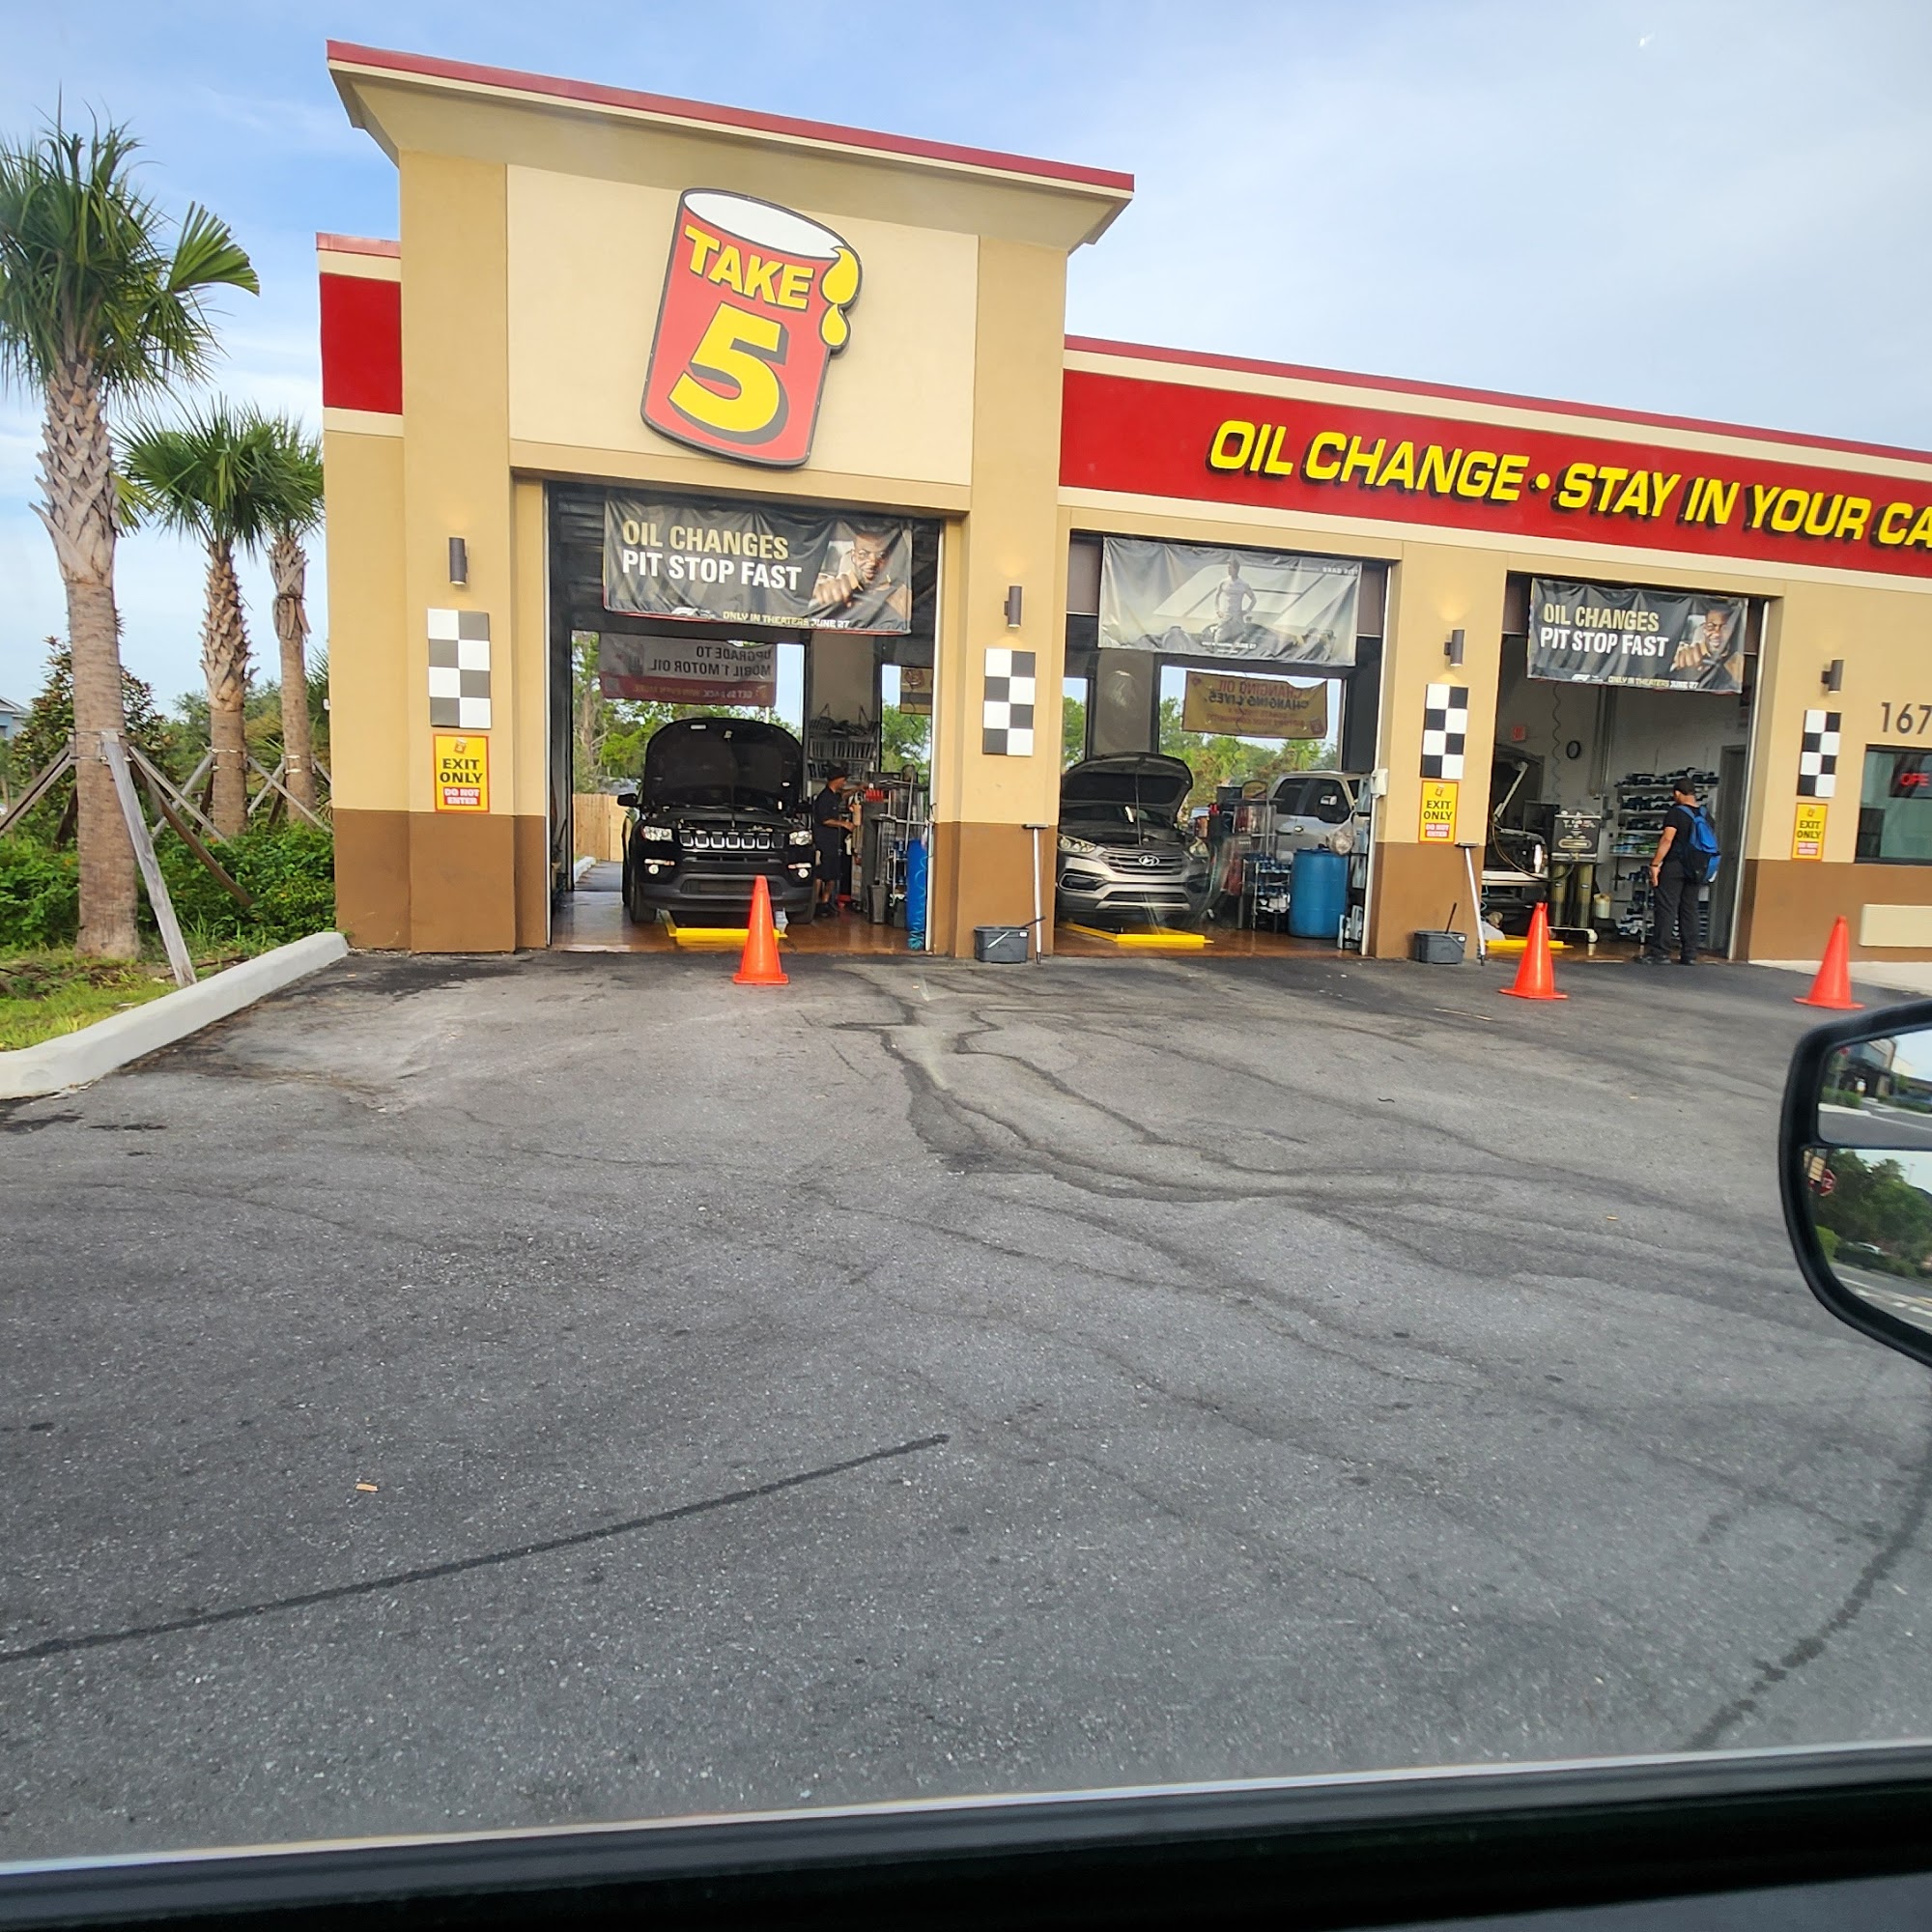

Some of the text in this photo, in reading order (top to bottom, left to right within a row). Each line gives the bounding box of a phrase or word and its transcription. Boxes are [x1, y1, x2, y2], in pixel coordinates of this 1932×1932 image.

[684, 224, 814, 310] TAKE
[668, 300, 788, 442] 5
[1209, 419, 1294, 475] OIL
[1304, 431, 1530, 501] CHANGE
[1557, 462, 1682, 518] STAY
[1684, 477, 1741, 526] IN
[1750, 484, 1872, 541] YOUR
[622, 520, 789, 561] OIL CHANGES
[622, 550, 803, 591] PIT STOP FAST
[723, 611, 750, 622] ONLY
[750, 613, 761, 623] IN
[762, 614, 810, 627] THEATERS
[810, 618, 837, 628] JUNE
[838, 619, 851, 629] 27
[1544, 603, 1660, 633] OIL CHANGES
[1540, 628, 1669, 658] PIT STOP FAST
[442, 758, 480, 771] EXIT
[440, 772, 483, 783] ONLY
[1423, 810, 1453, 820] ONLY
[1426, 800, 1451, 810] EXIT
[1797, 830, 1822, 839] ONLY
[1799, 820, 1821, 830] EXIT
